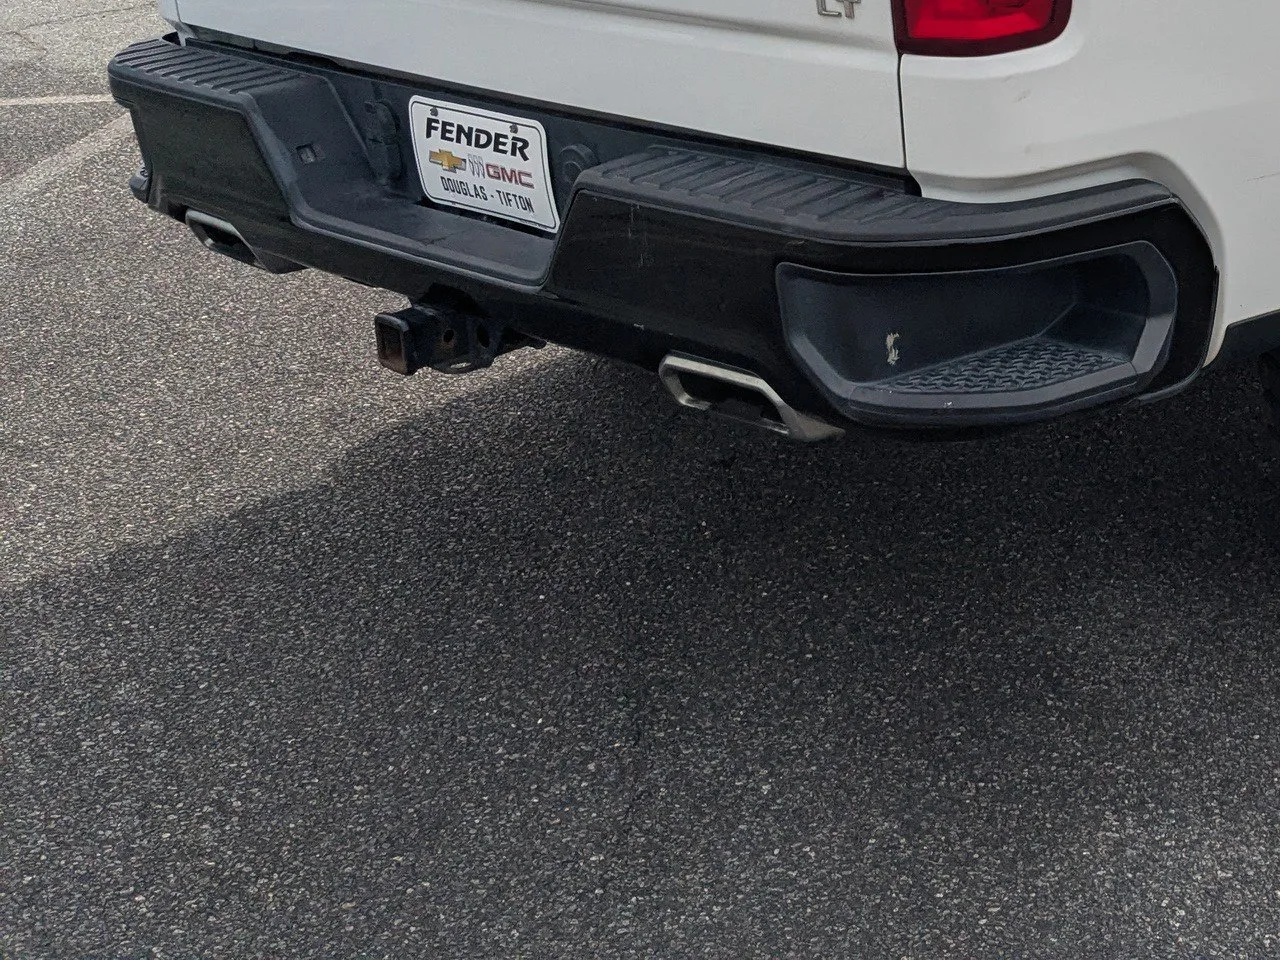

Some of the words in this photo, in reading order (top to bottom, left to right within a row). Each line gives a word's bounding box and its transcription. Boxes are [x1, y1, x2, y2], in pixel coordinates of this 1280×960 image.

[425, 116, 530, 162] FENDER
[440, 175, 488, 201] DOUGLAS
[495, 189, 535, 213] TIFTON
[485, 162, 535, 189] GMC
